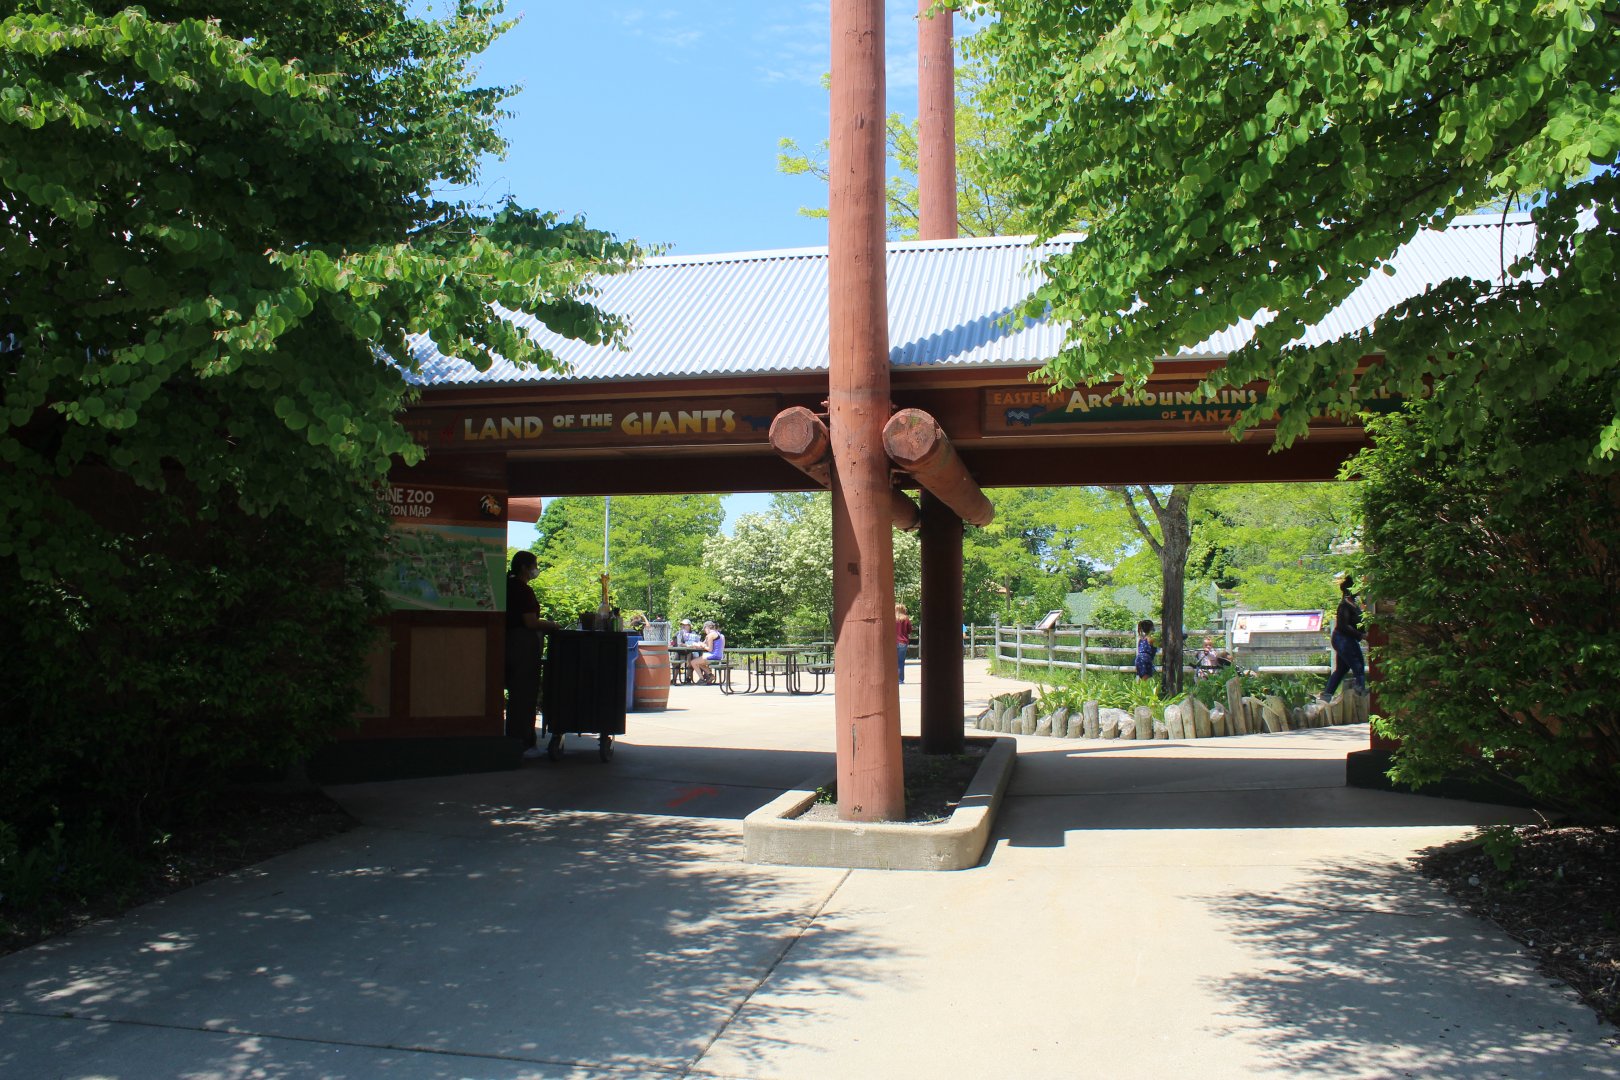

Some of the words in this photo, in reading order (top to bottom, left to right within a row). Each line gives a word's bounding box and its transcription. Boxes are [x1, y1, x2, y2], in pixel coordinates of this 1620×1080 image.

[993, 391, 1065, 404] EASTERN
[1161, 411, 1177, 420] OF
[463, 416, 544, 441] LAND
[552, 414, 575, 428] OF
[580, 413, 613, 428] THE
[620, 408, 737, 436] GIANTS
[376, 487, 404, 503] CINE
[406, 489, 434, 504] ZOO
[409, 504, 432, 518] MAP
